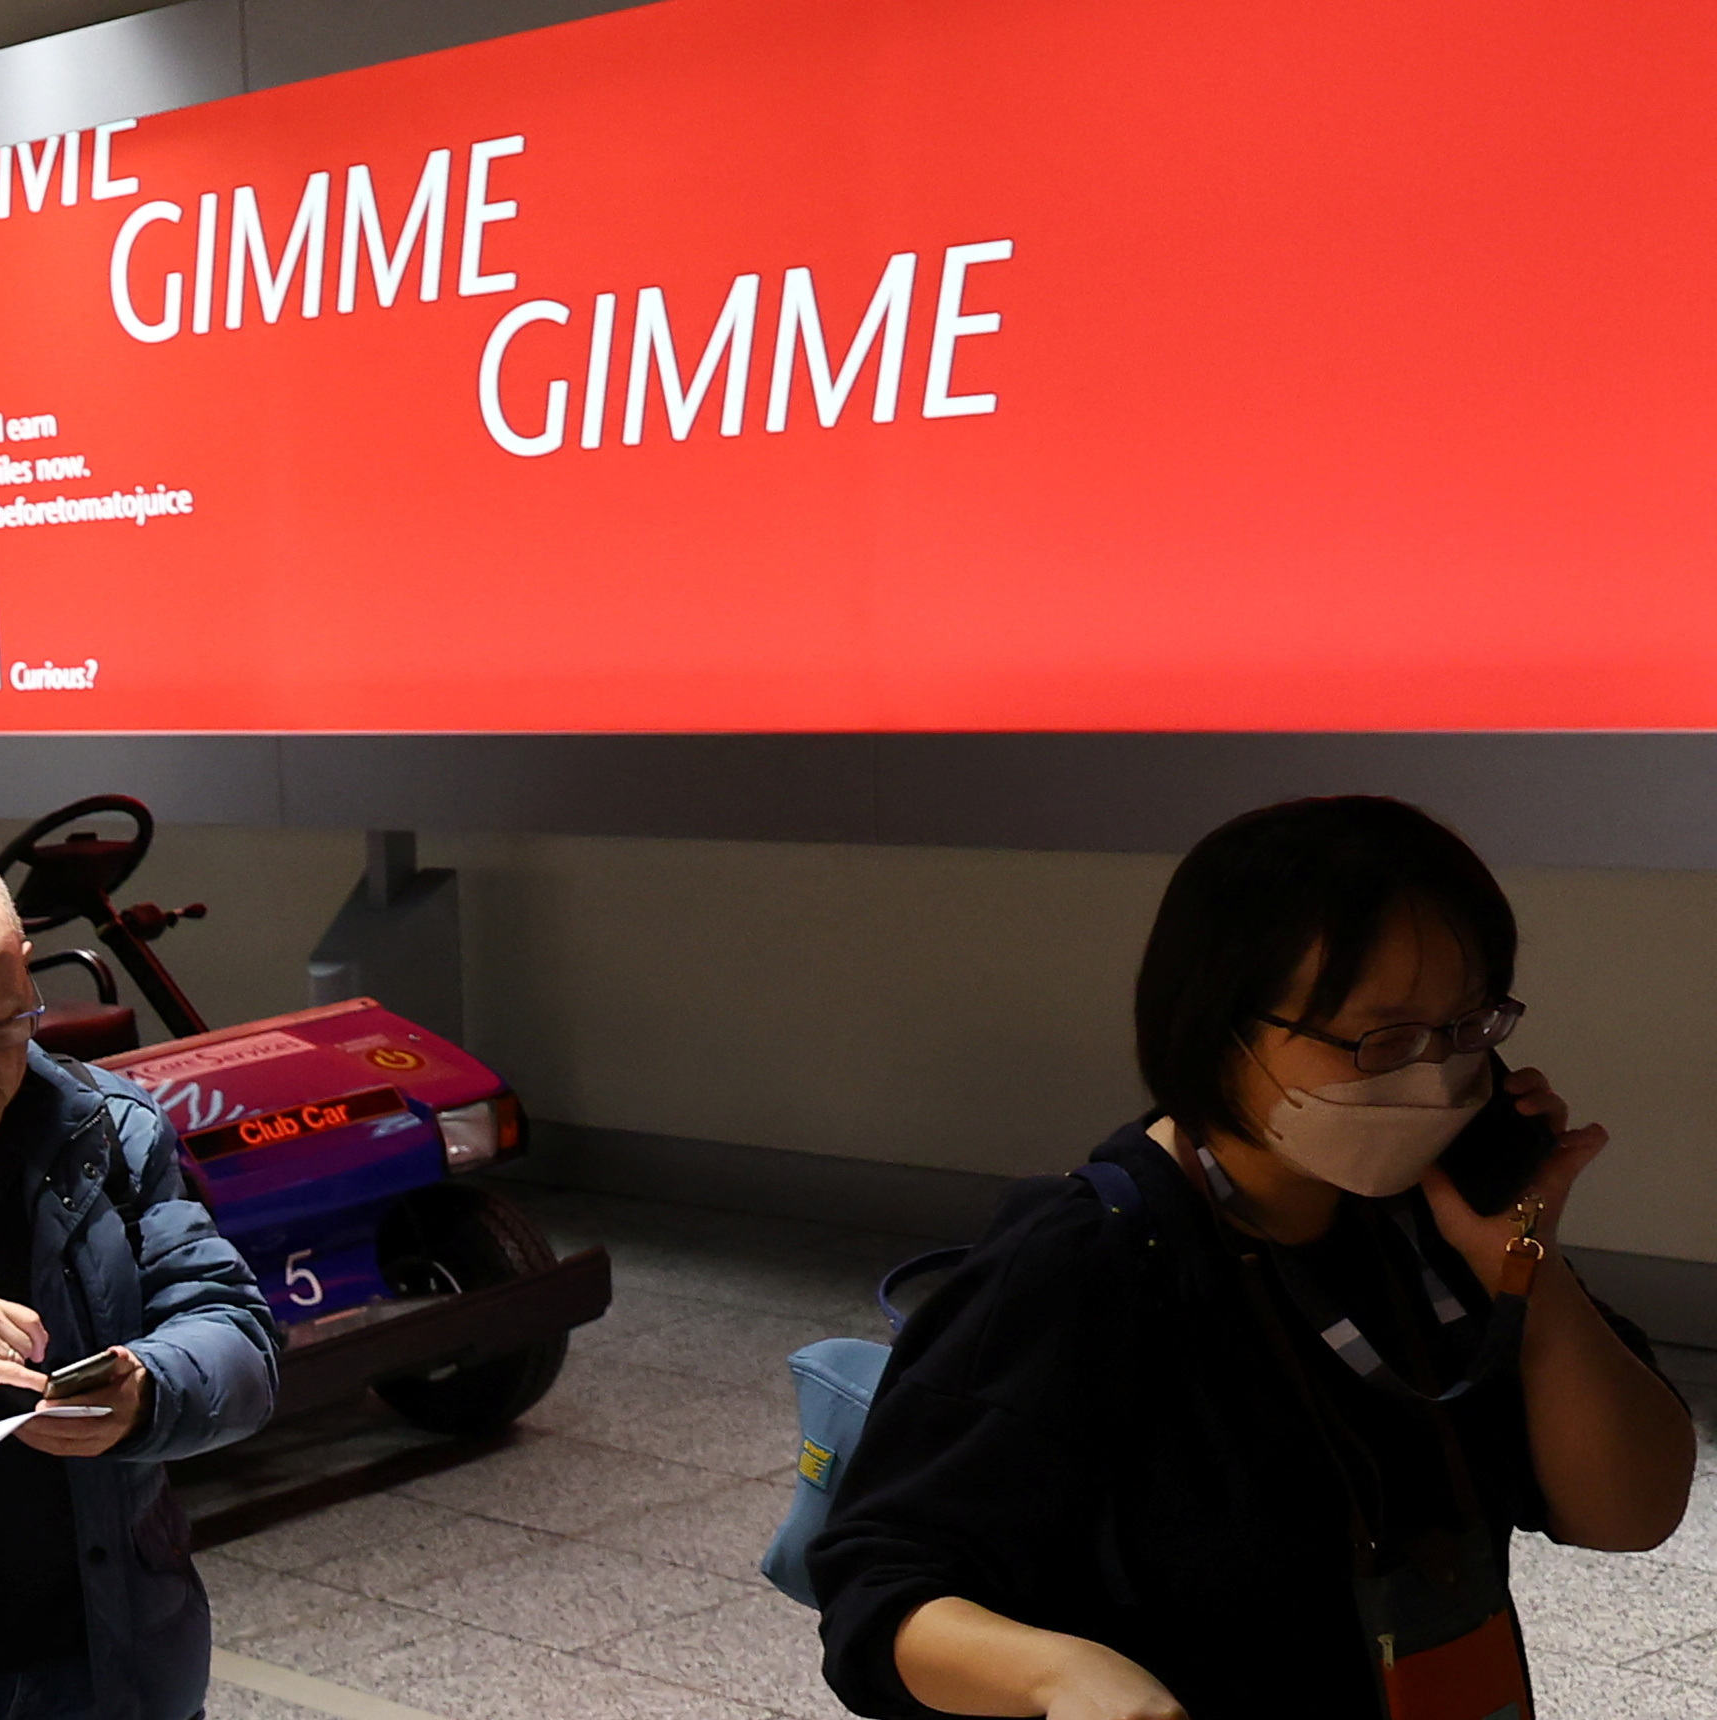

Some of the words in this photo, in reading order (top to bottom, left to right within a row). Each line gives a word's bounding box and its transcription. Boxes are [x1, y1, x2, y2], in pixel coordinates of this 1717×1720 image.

[109, 134, 525, 343] GIMME
[477, 238, 1014, 457] GIMME
[6, 414, 59, 441] earn
[35, 454, 92, 482] now.
[9, 658, 99, 691] Curious?
[238, 1116, 300, 1145] Club
[300, 1102, 351, 1128] Car
[285, 1248, 324, 1307] 5
